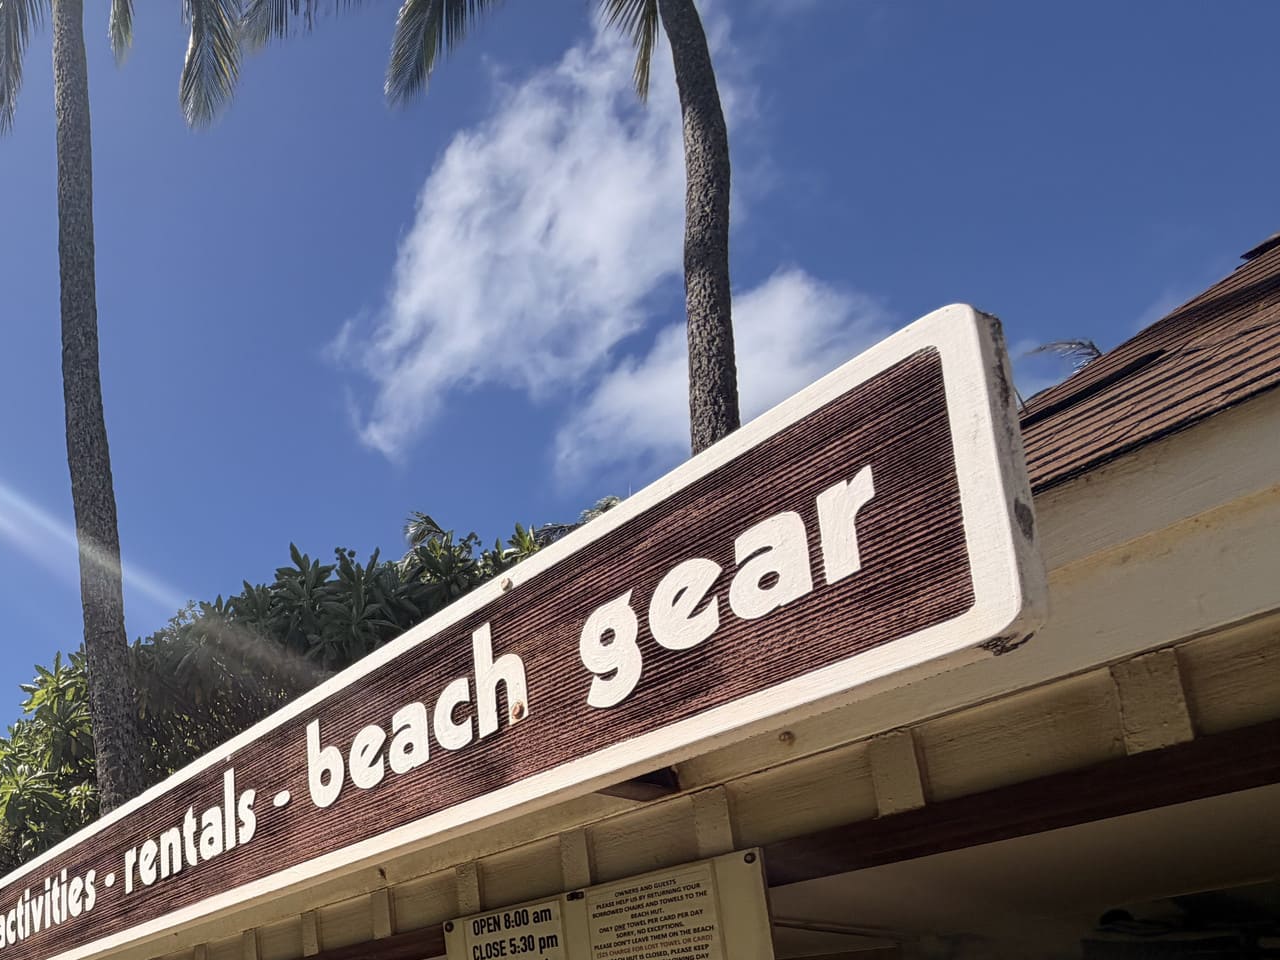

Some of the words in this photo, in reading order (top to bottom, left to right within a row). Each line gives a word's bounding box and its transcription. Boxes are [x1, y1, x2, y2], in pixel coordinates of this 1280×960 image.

[125, 767, 257, 895] rentals
[306, 622, 529, 808] beach
[579, 464, 875, 708] gear
[596, 902, 615, 910] PLEASE
[647, 887, 681, 899] RETURNING
[682, 883, 700, 891] YOUR
[615, 887, 639, 897] OWNERS
[654, 879, 676, 888] GUESTS
[592, 908, 623, 919] BORROWED
[624, 903, 644, 912] CHAIRS
[660, 895, 684, 905] TOWELS
[473, 915, 501, 935] OPEN
[504, 909, 529, 929] 8:00
[533, 909, 552, 923] am
[647, 922, 684, 933] EXCEPTIONS.
[473, 940, 507, 960] CLOSE
[509, 935, 535, 954] 5:30
[539, 935, 558, 954] pm
[594, 942, 612, 951] PLEASE
[693, 925, 714, 933] BEACH
[646, 950, 669, 959] CLOSED,
[671, 946, 692, 954] PLEASE
